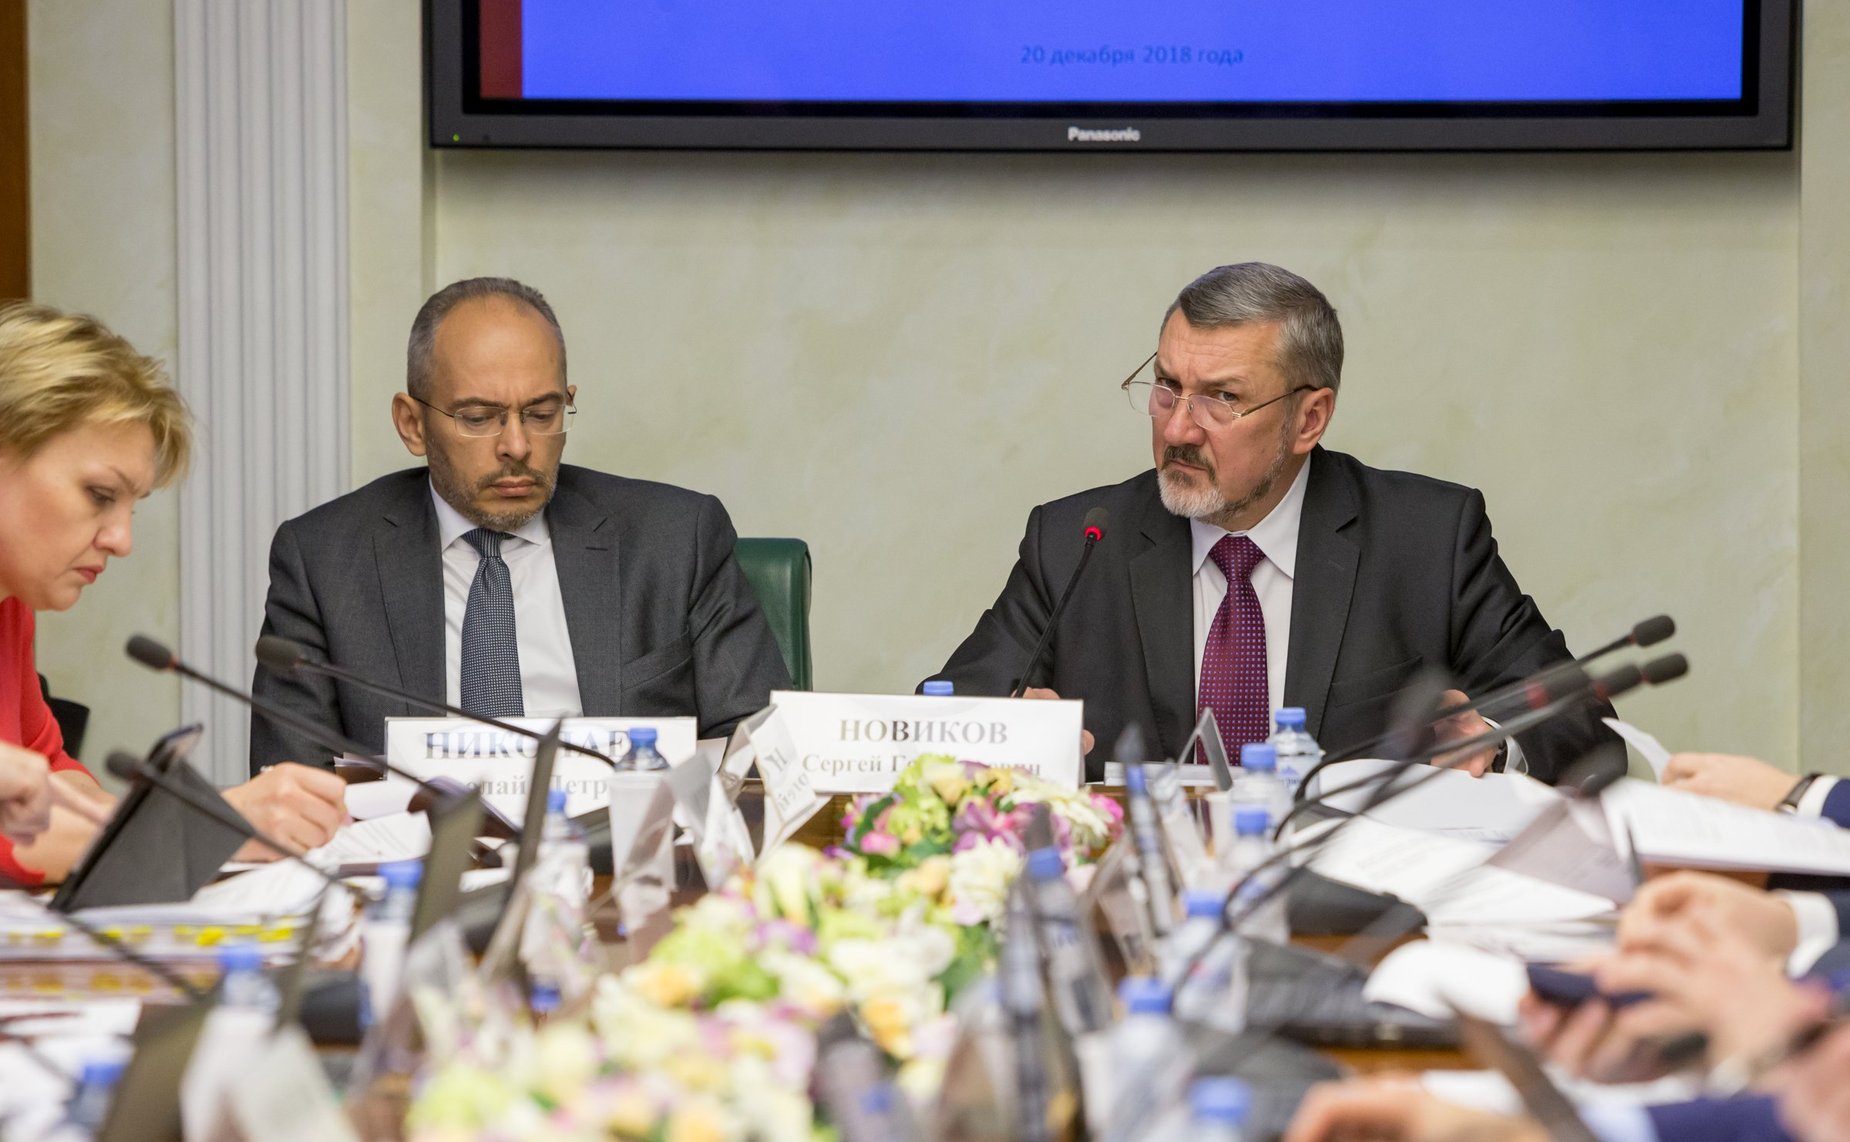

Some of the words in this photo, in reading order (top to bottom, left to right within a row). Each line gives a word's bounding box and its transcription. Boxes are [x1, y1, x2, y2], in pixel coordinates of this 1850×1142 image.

[1020, 45, 1045, 64] 20
[1050, 45, 1135, 67] декабря
[1143, 45, 1192, 64] 2018
[1198, 48, 1244, 66] года
[1067, 126, 1141, 142] Panasonic
[839, 718, 1008, 745] НОВИКОВ
[424, 729, 630, 760] НИКОЛАЕ
[801, 753, 882, 777] Сергей
